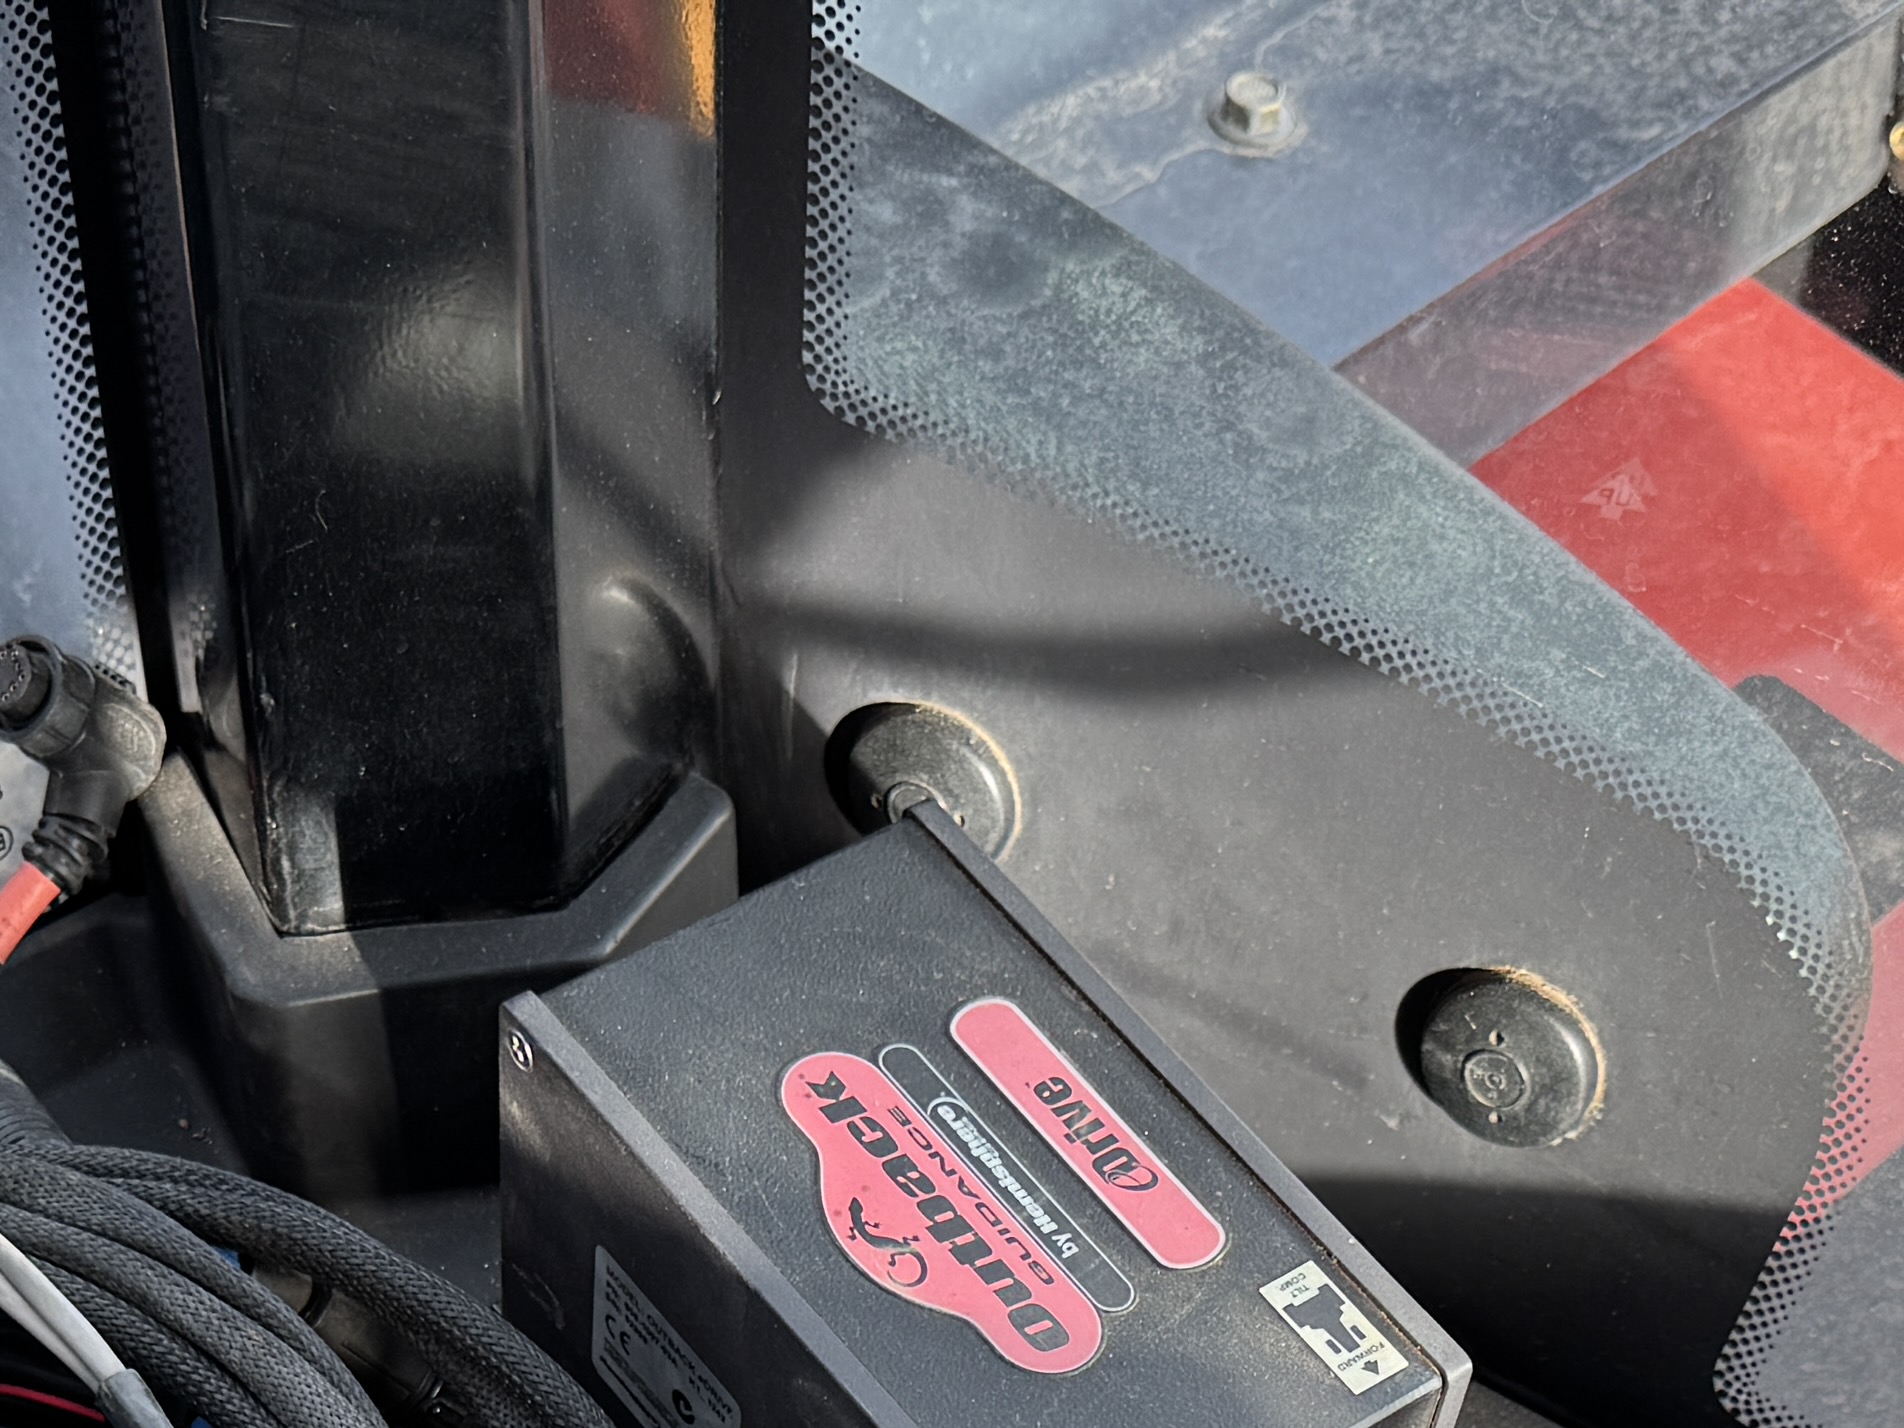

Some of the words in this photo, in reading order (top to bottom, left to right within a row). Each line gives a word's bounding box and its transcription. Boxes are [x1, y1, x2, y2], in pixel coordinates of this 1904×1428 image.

[804, 1070, 1070, 1353] Outback
[886, 1105, 1056, 1287] GUIDANCE
[935, 1103, 1059, 1236] Hemisphere
[1051, 1231, 1081, 1260] by
[1336, 1340, 1386, 1372] FORWARD
